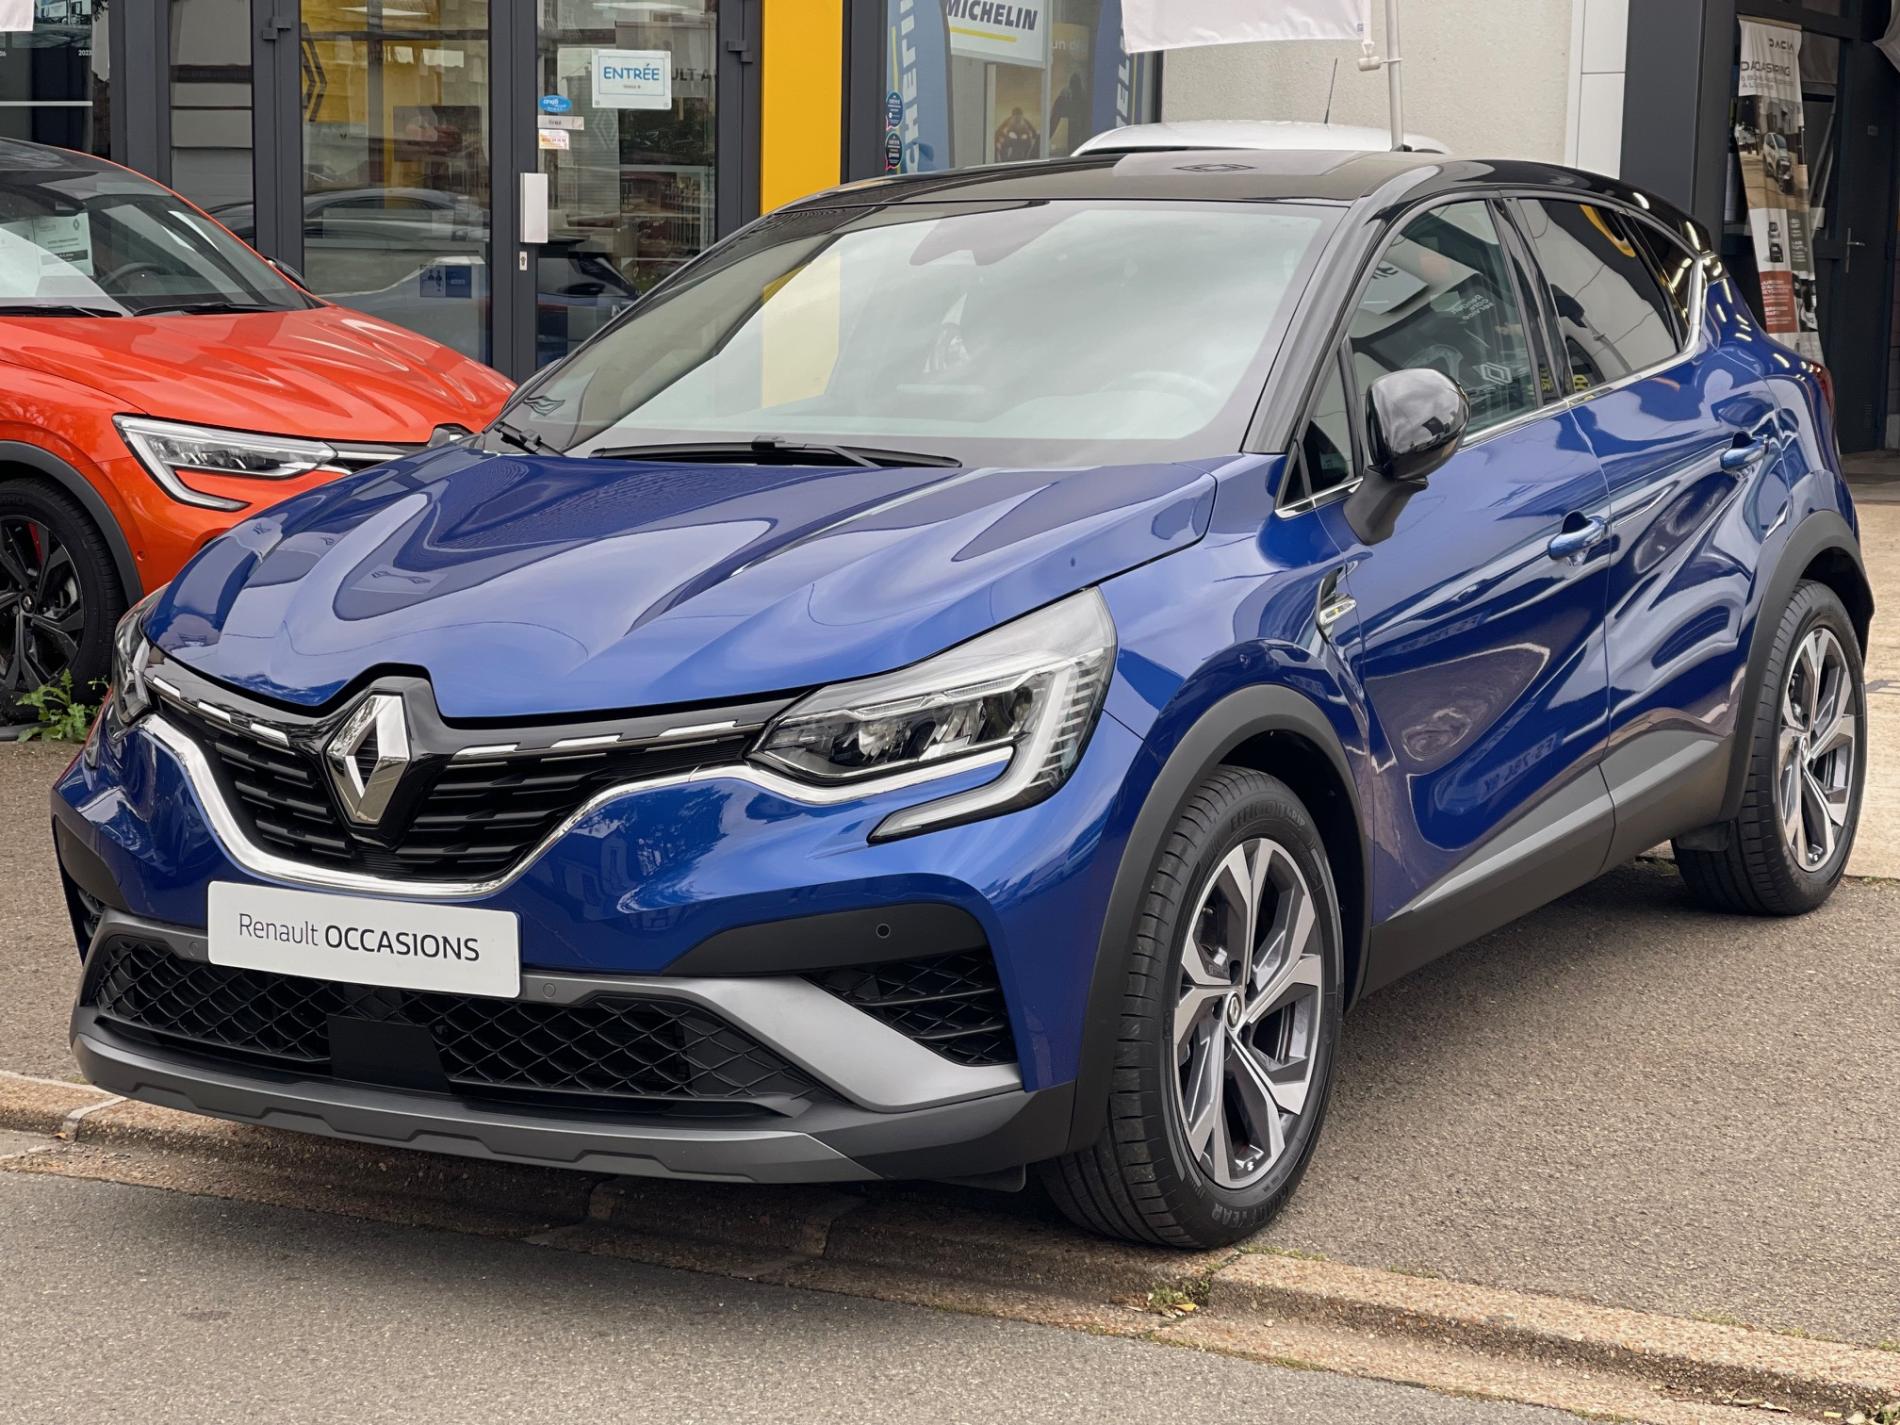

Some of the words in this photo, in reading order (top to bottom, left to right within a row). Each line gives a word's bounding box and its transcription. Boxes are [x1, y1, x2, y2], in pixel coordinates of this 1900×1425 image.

[947, 0, 1038, 30] MICHELIN
[603, 63, 661, 81] ENTRÉE
[239, 913, 318, 946] Renault
[324, 924, 480, 961] OCCASIONS
